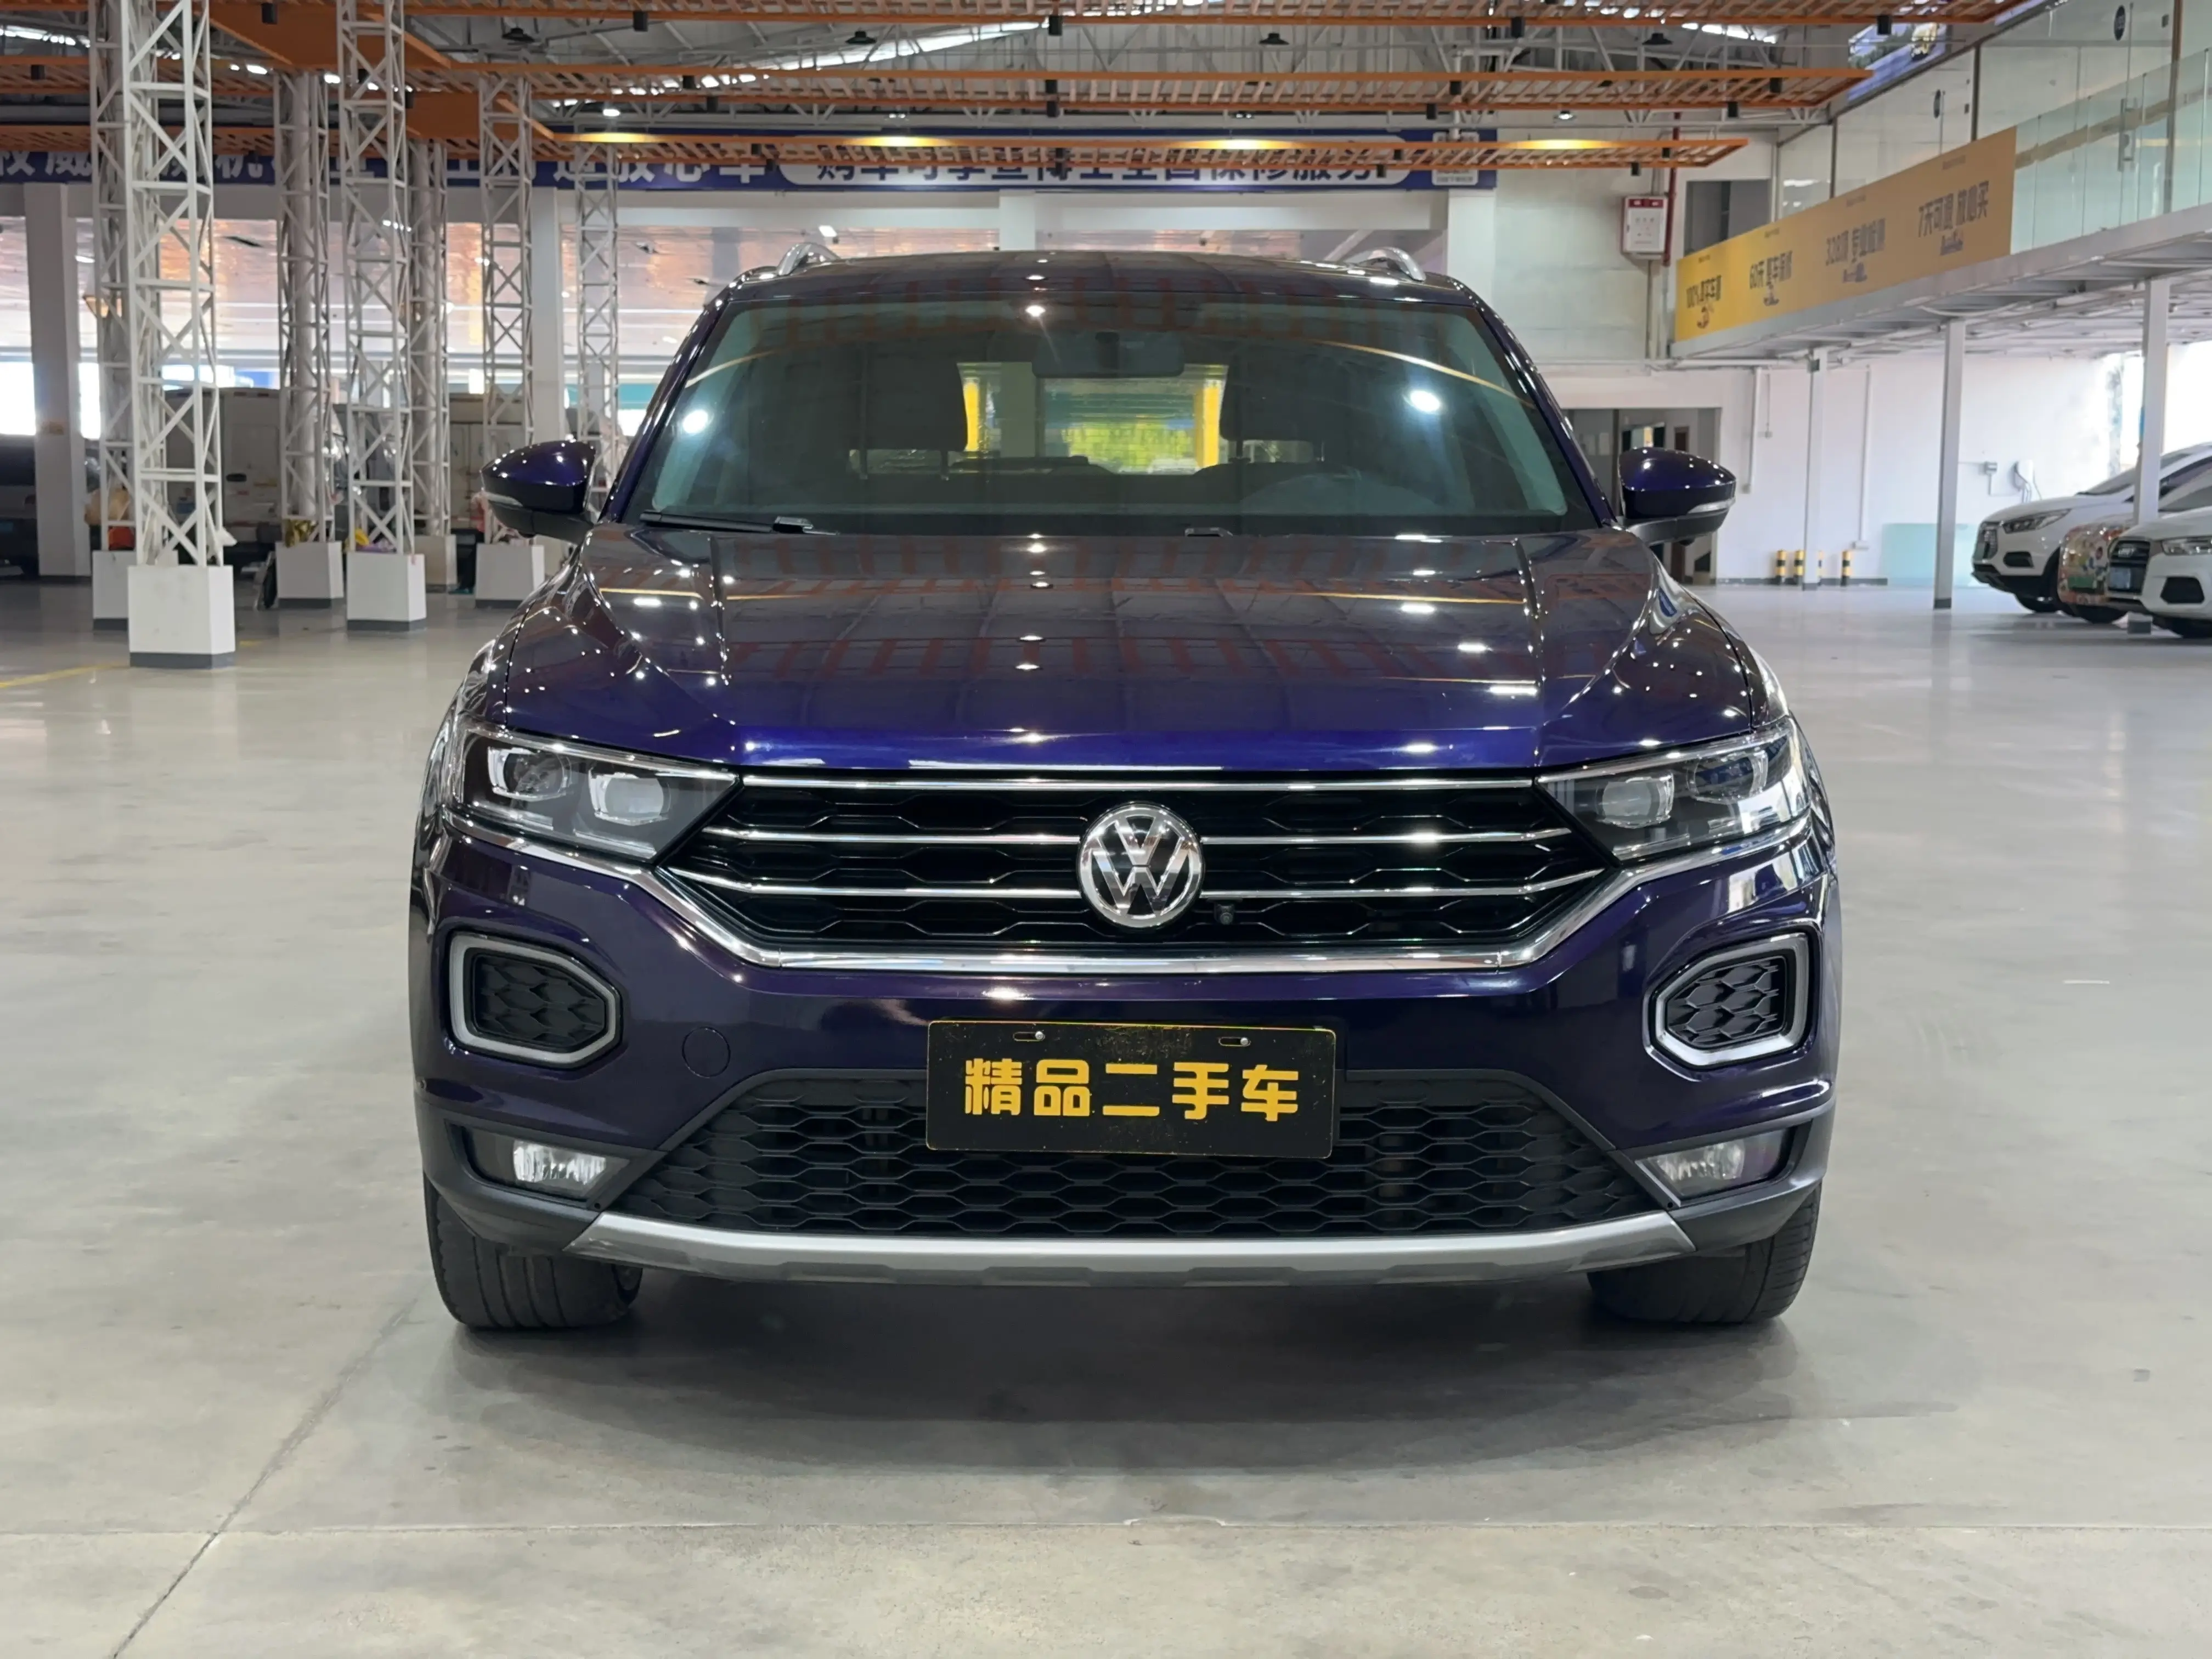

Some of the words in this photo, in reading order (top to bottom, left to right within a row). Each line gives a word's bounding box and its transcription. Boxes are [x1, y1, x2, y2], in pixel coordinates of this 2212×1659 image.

[965, 1058, 1299, 1122] 精品二手车
